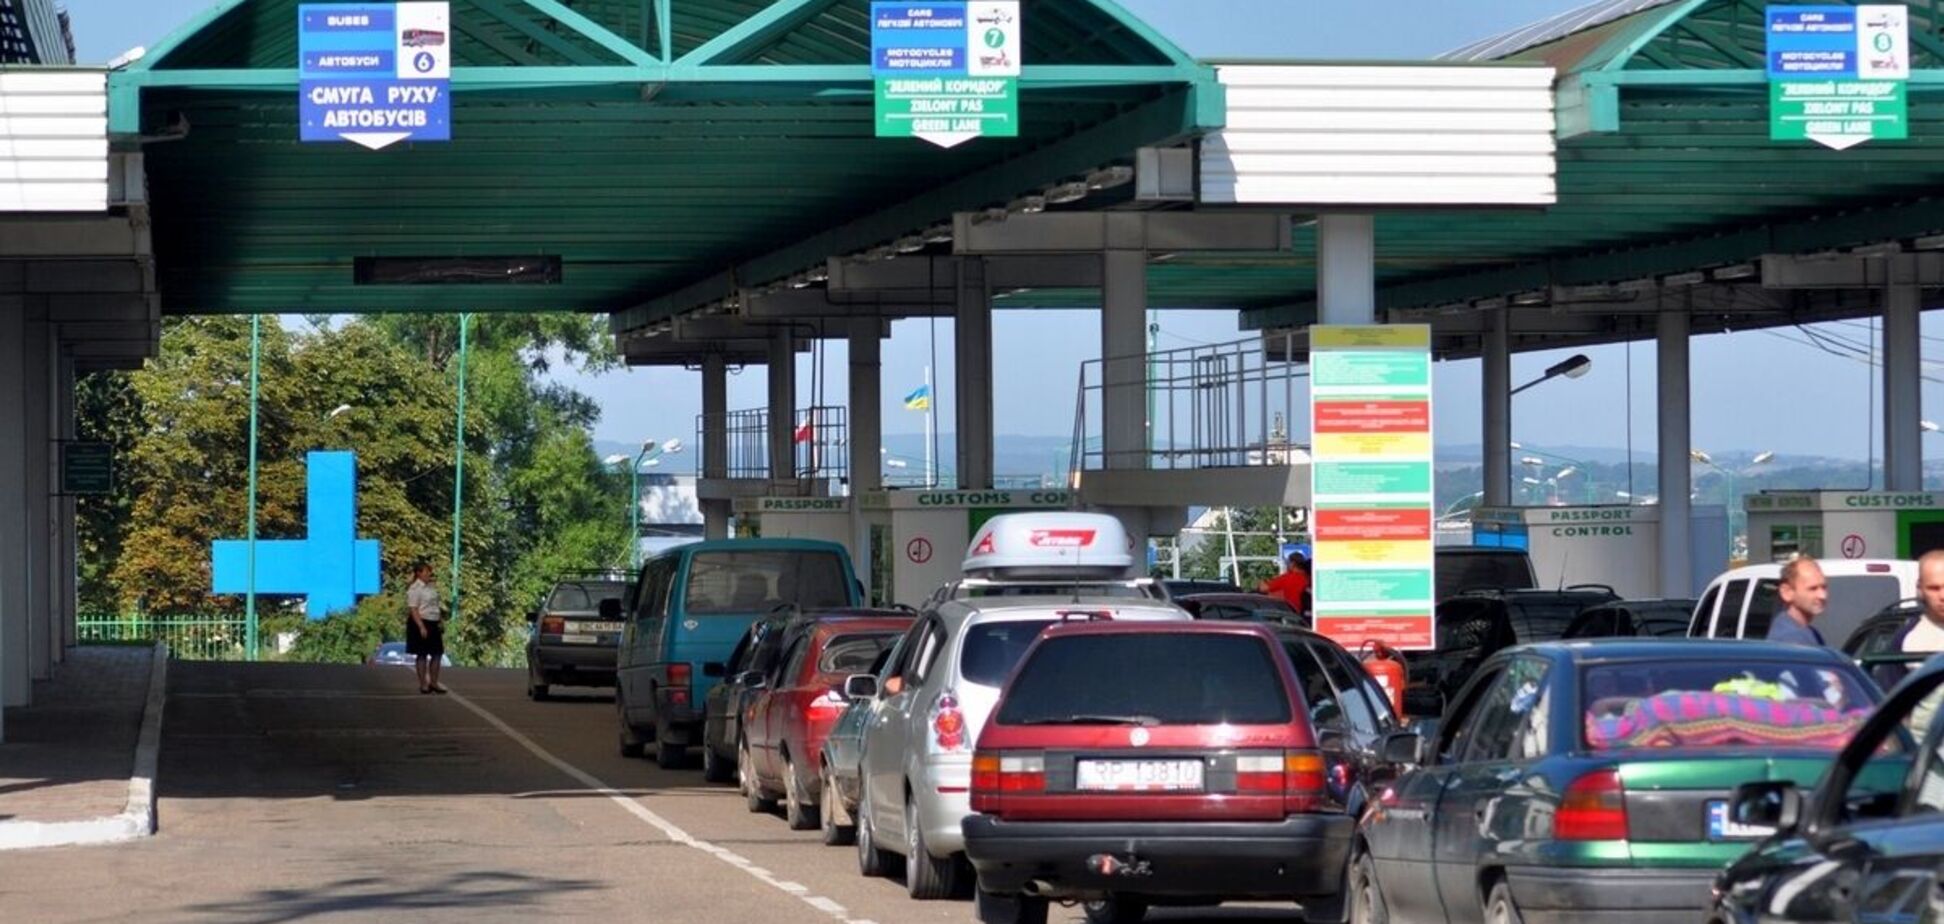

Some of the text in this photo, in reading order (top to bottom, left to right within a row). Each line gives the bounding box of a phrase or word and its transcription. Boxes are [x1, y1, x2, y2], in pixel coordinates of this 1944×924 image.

[989, 31, 1000, 46] 7
[318, 56, 379, 66] АВТОБУСИ
[418, 54, 429, 70] 6
[311, 86, 437, 104] СМУГА РУХУ
[960, 100, 983, 112] PAS
[323, 110, 427, 127] АВТОБУСІВ
[764, 500, 843, 509] PASSPORT
[918, 493, 1011, 505] CUSTOMS
[1846, 495, 1934, 507] CUSTOMS
[1551, 509, 1632, 521] PASSPORT
[1552, 526, 1633, 537] CONTROL
